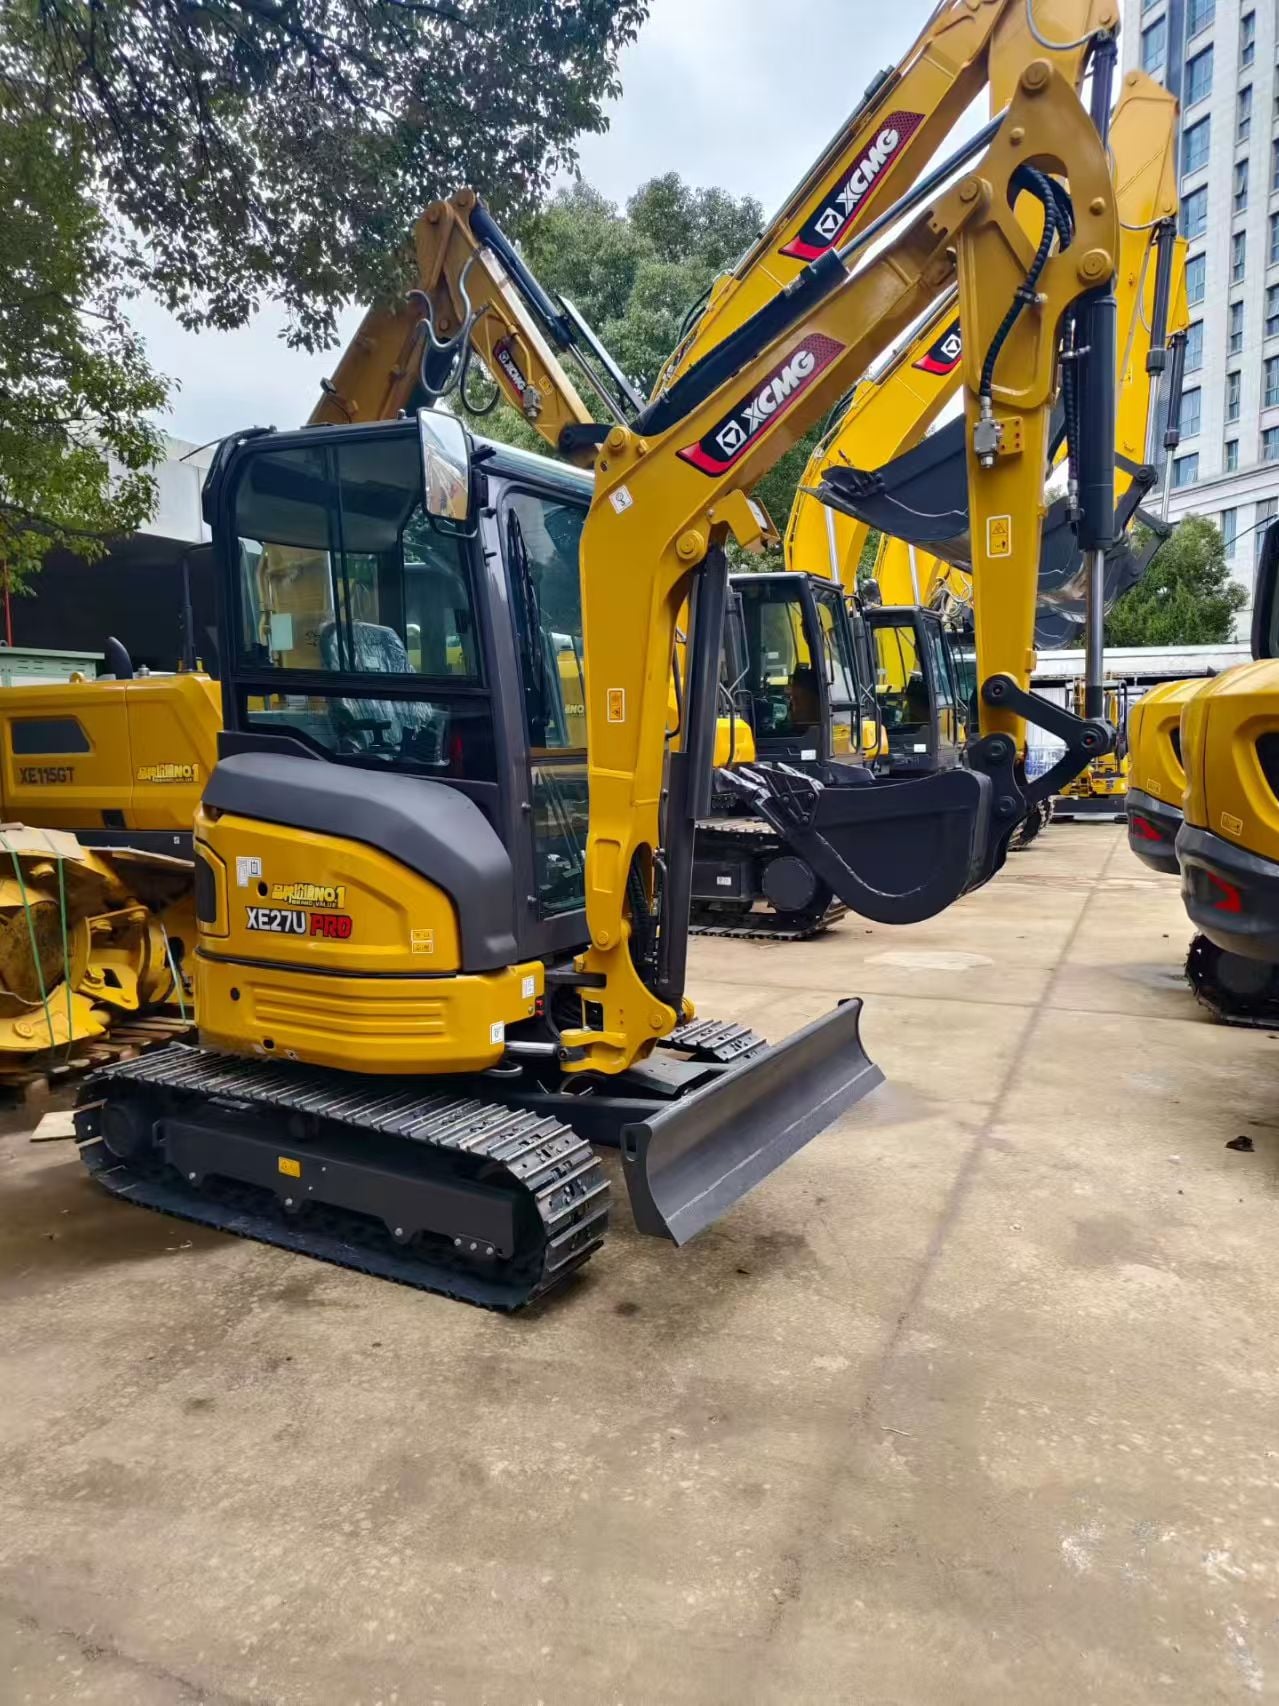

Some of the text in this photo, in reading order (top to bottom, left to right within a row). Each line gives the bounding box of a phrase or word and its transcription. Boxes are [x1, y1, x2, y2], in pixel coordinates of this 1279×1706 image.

[835, 128, 899, 217] XCMG
[503, 360, 526, 391] XCMG
[741, 350, 815, 434] XCMG
[19, 766, 75, 784] XE115GT
[245, 906, 353, 938] XE27U PRO
